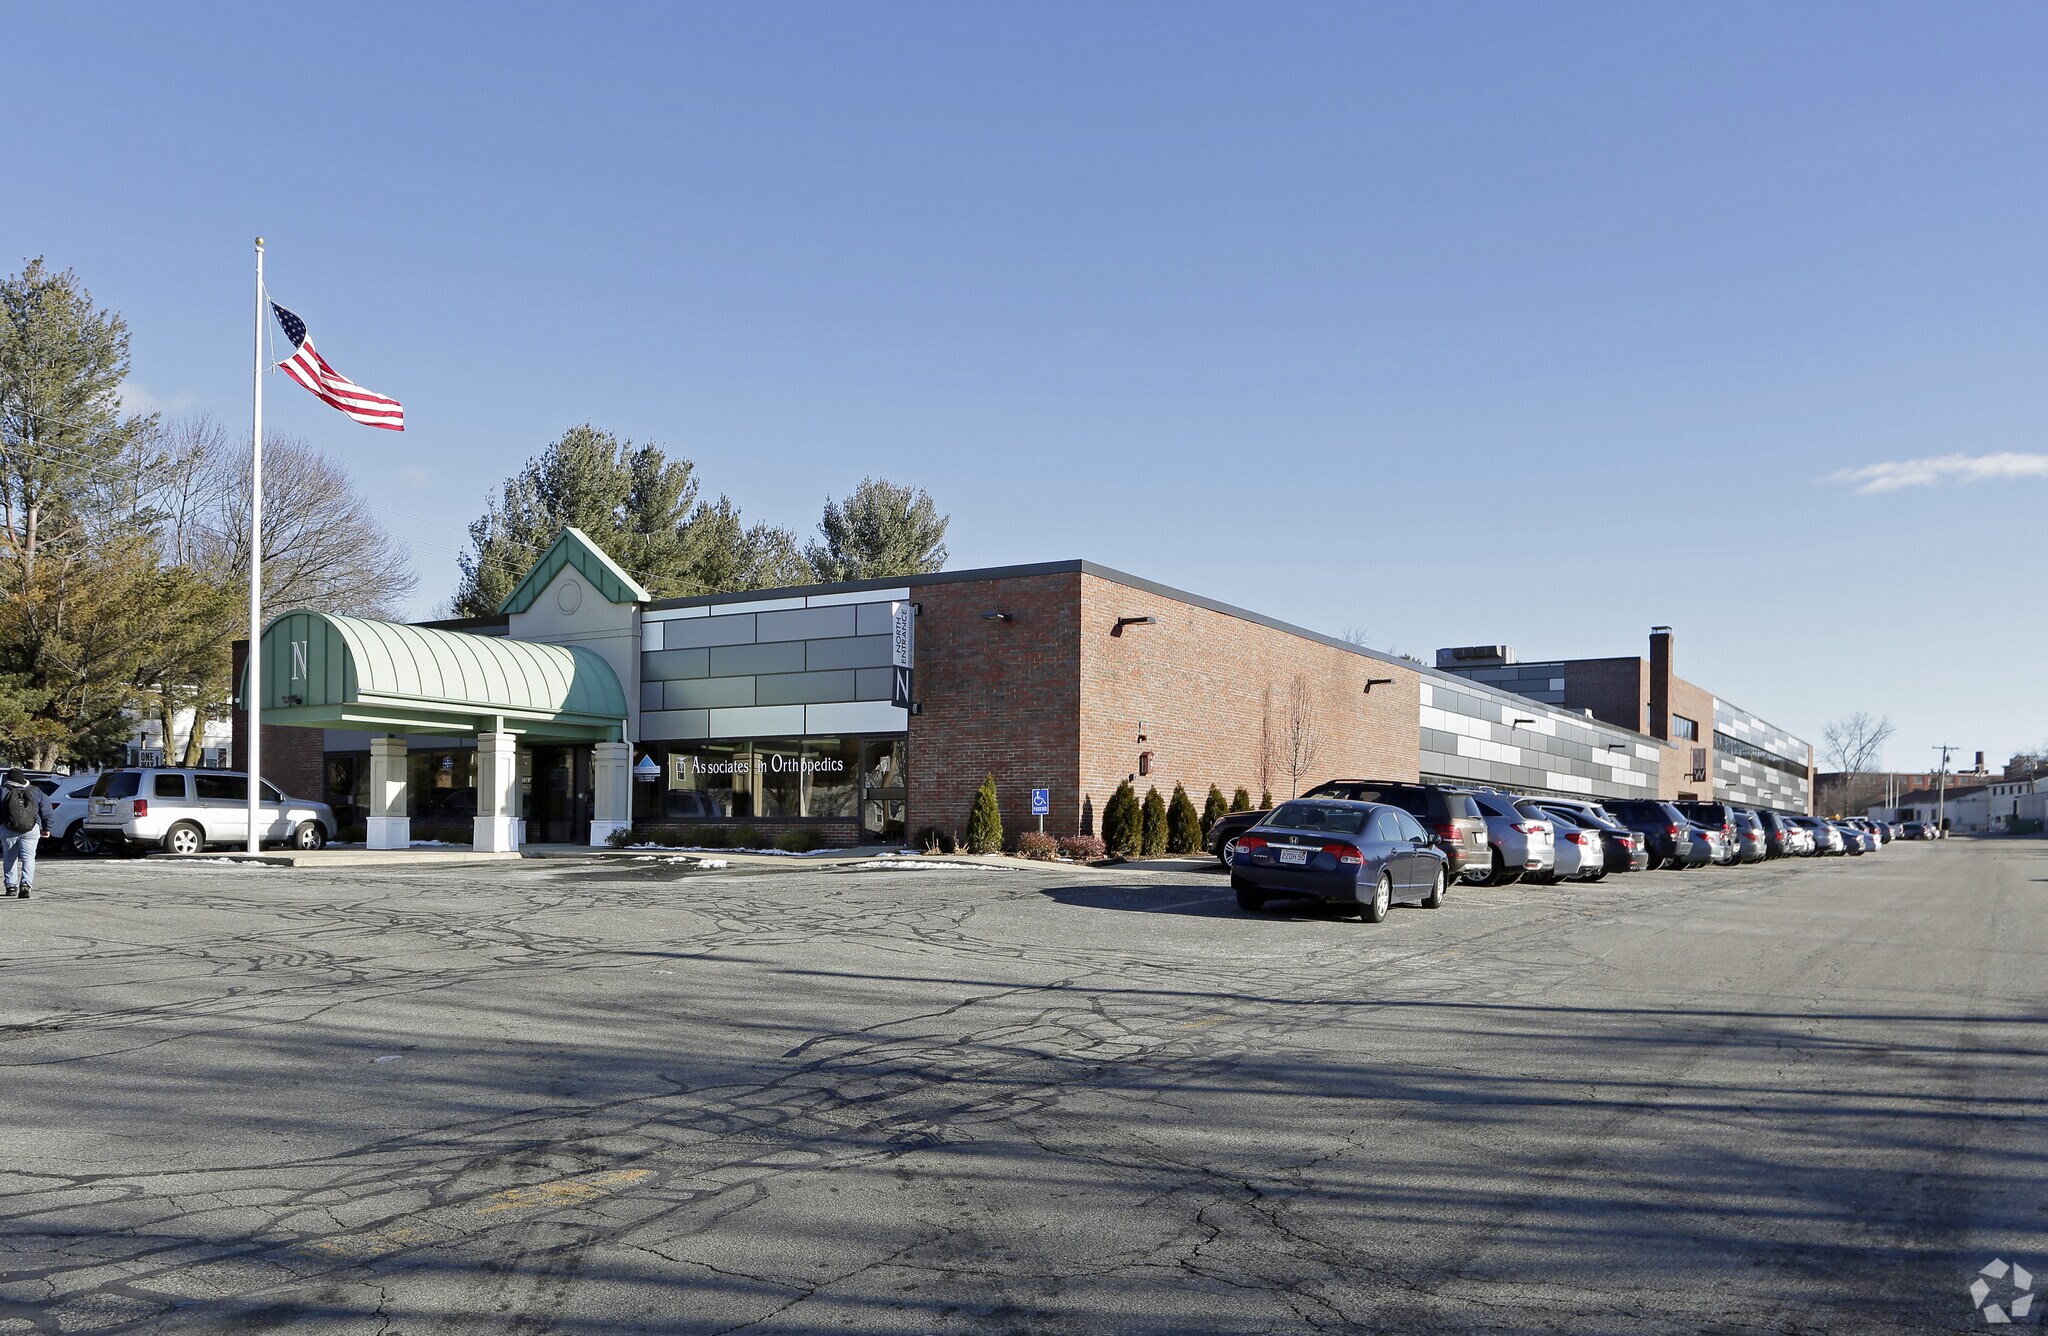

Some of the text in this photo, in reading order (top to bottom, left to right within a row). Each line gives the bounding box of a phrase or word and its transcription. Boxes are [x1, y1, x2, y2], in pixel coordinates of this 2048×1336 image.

[291, 640, 308, 680] N
[896, 667, 909, 703] N
[141, 752, 154, 761] ONE
[757, 759, 767, 773] in
[771, 753, 844, 775] Orthopedics
